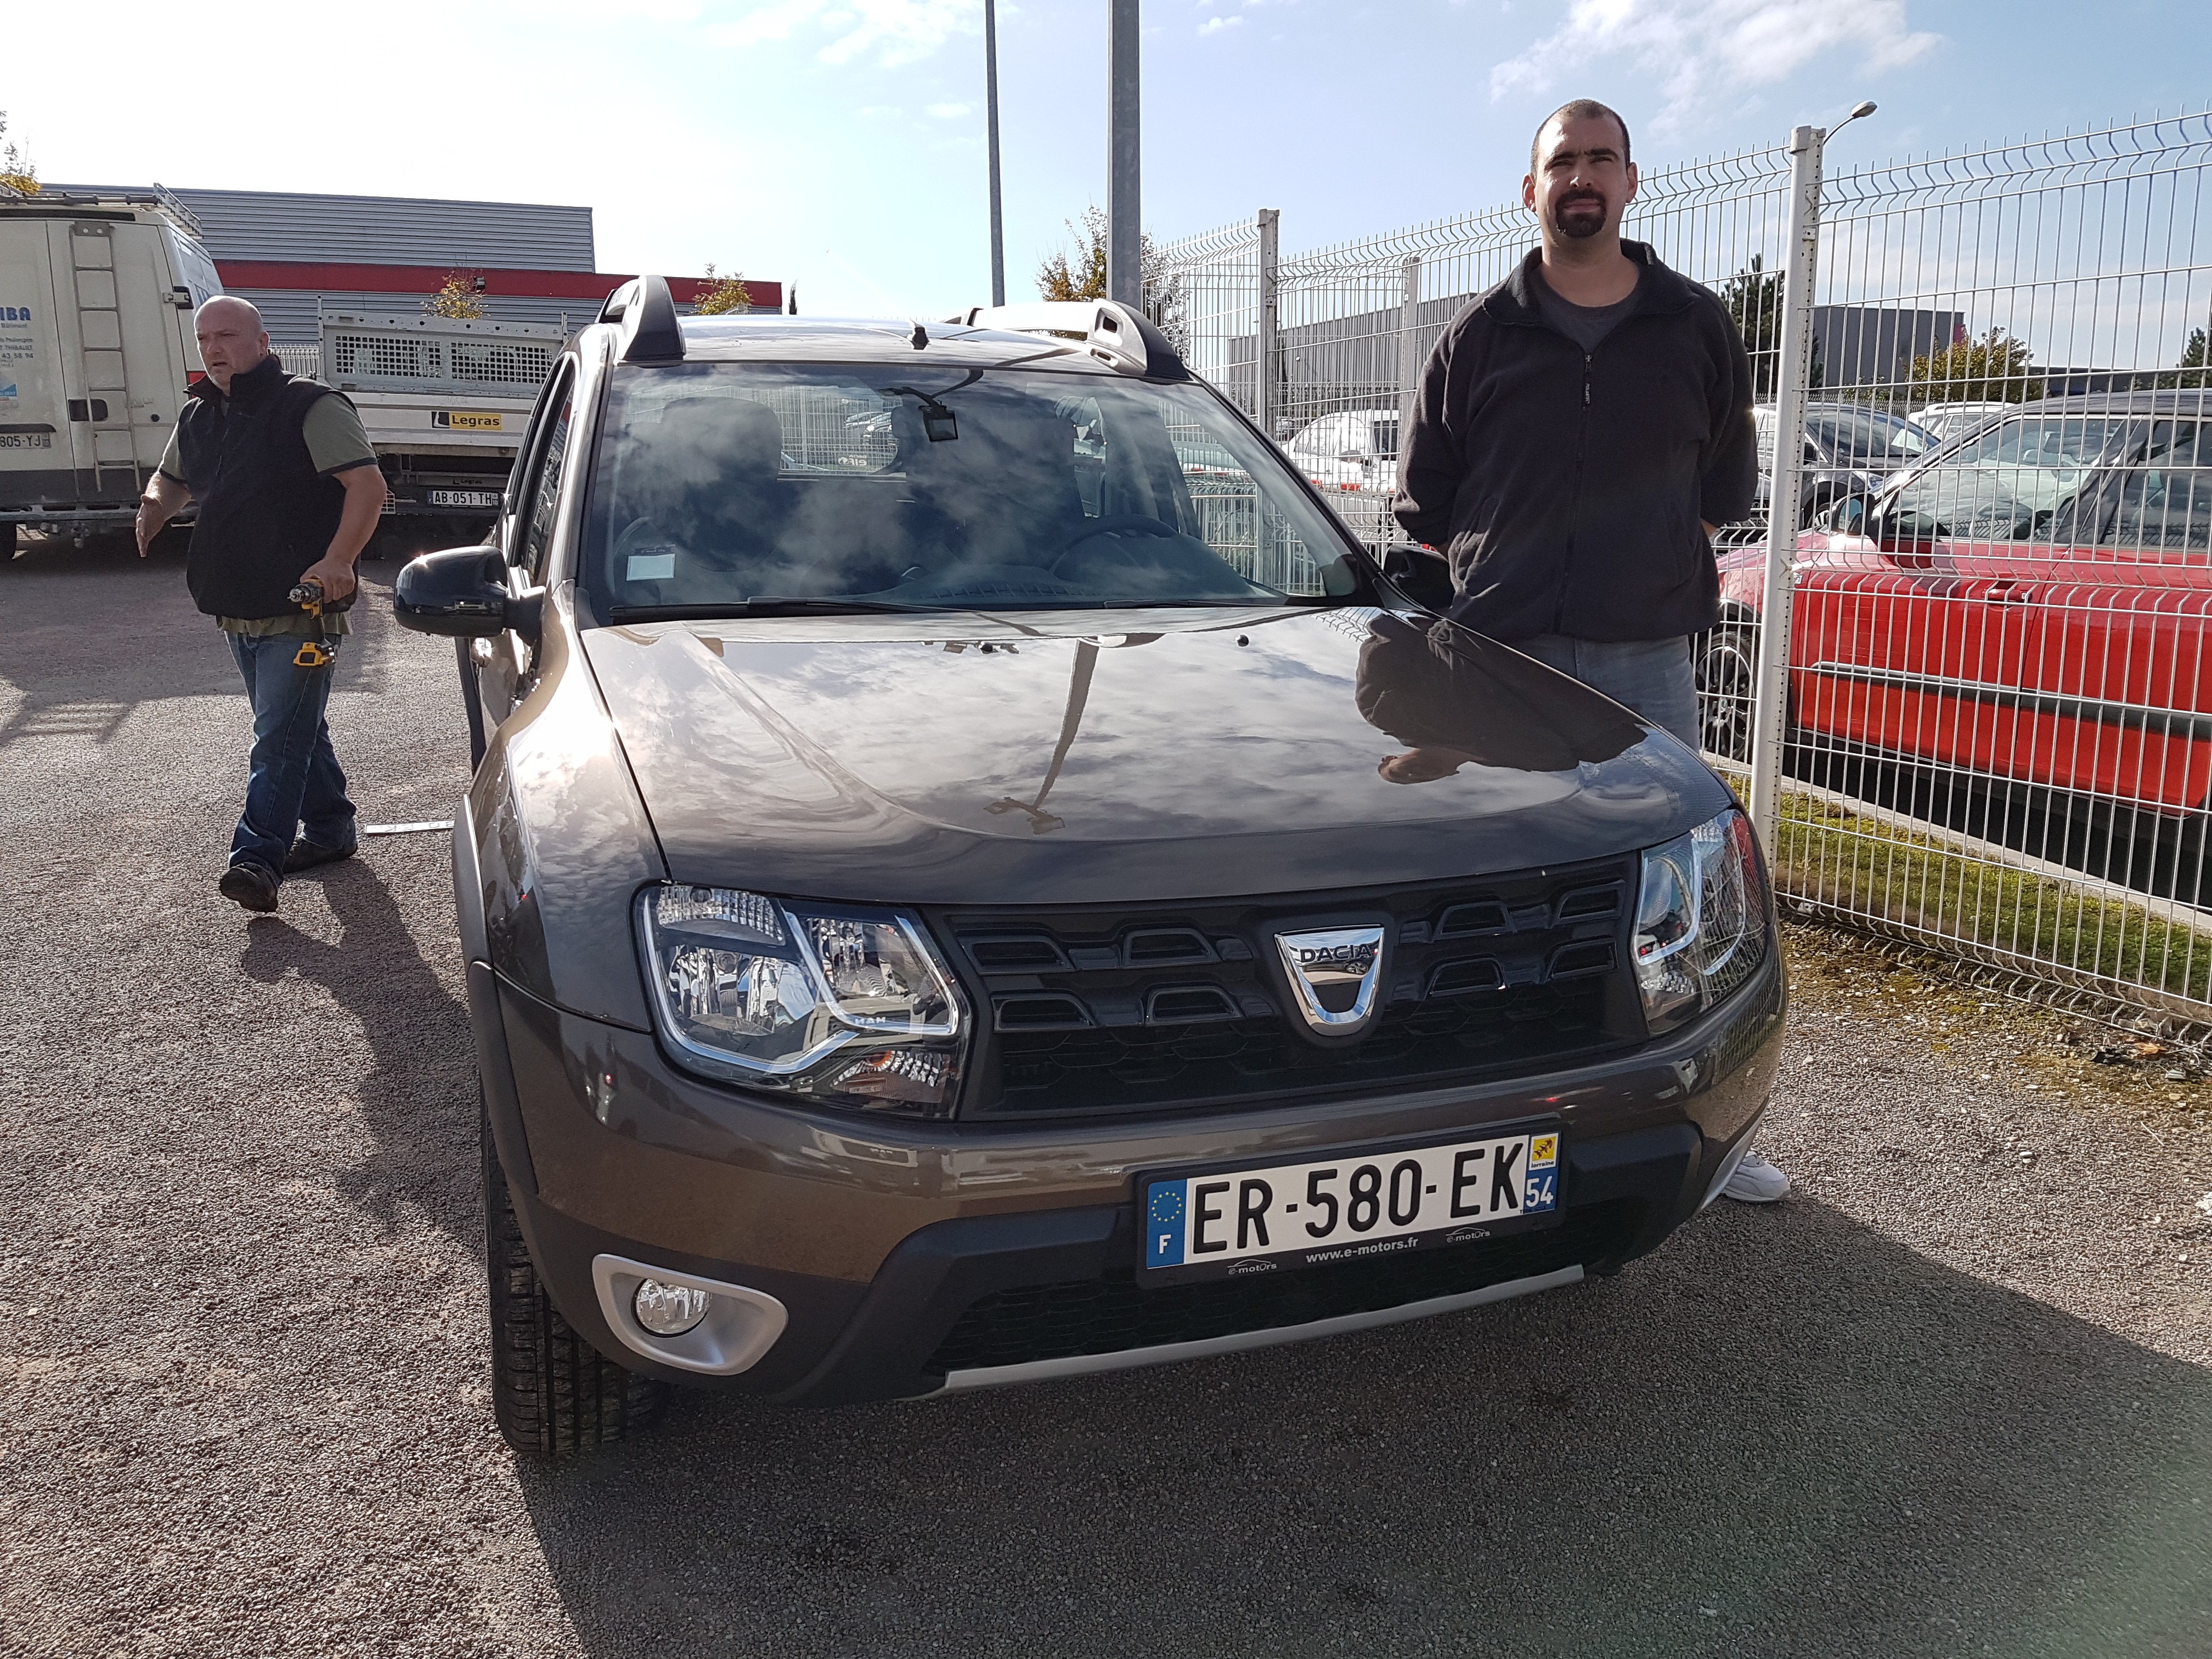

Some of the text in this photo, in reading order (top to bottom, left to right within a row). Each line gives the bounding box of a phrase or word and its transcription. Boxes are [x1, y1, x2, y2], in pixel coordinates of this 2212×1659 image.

[452, 415, 500, 427] Legras
[435, 492, 492, 504] AB-051-TH
[1300, 944, 1372, 963] DACIA
[1159, 1143, 1554, 1254] F ER-580-EK 54
[1305, 1237, 1419, 1263] www.e-motors.fr
